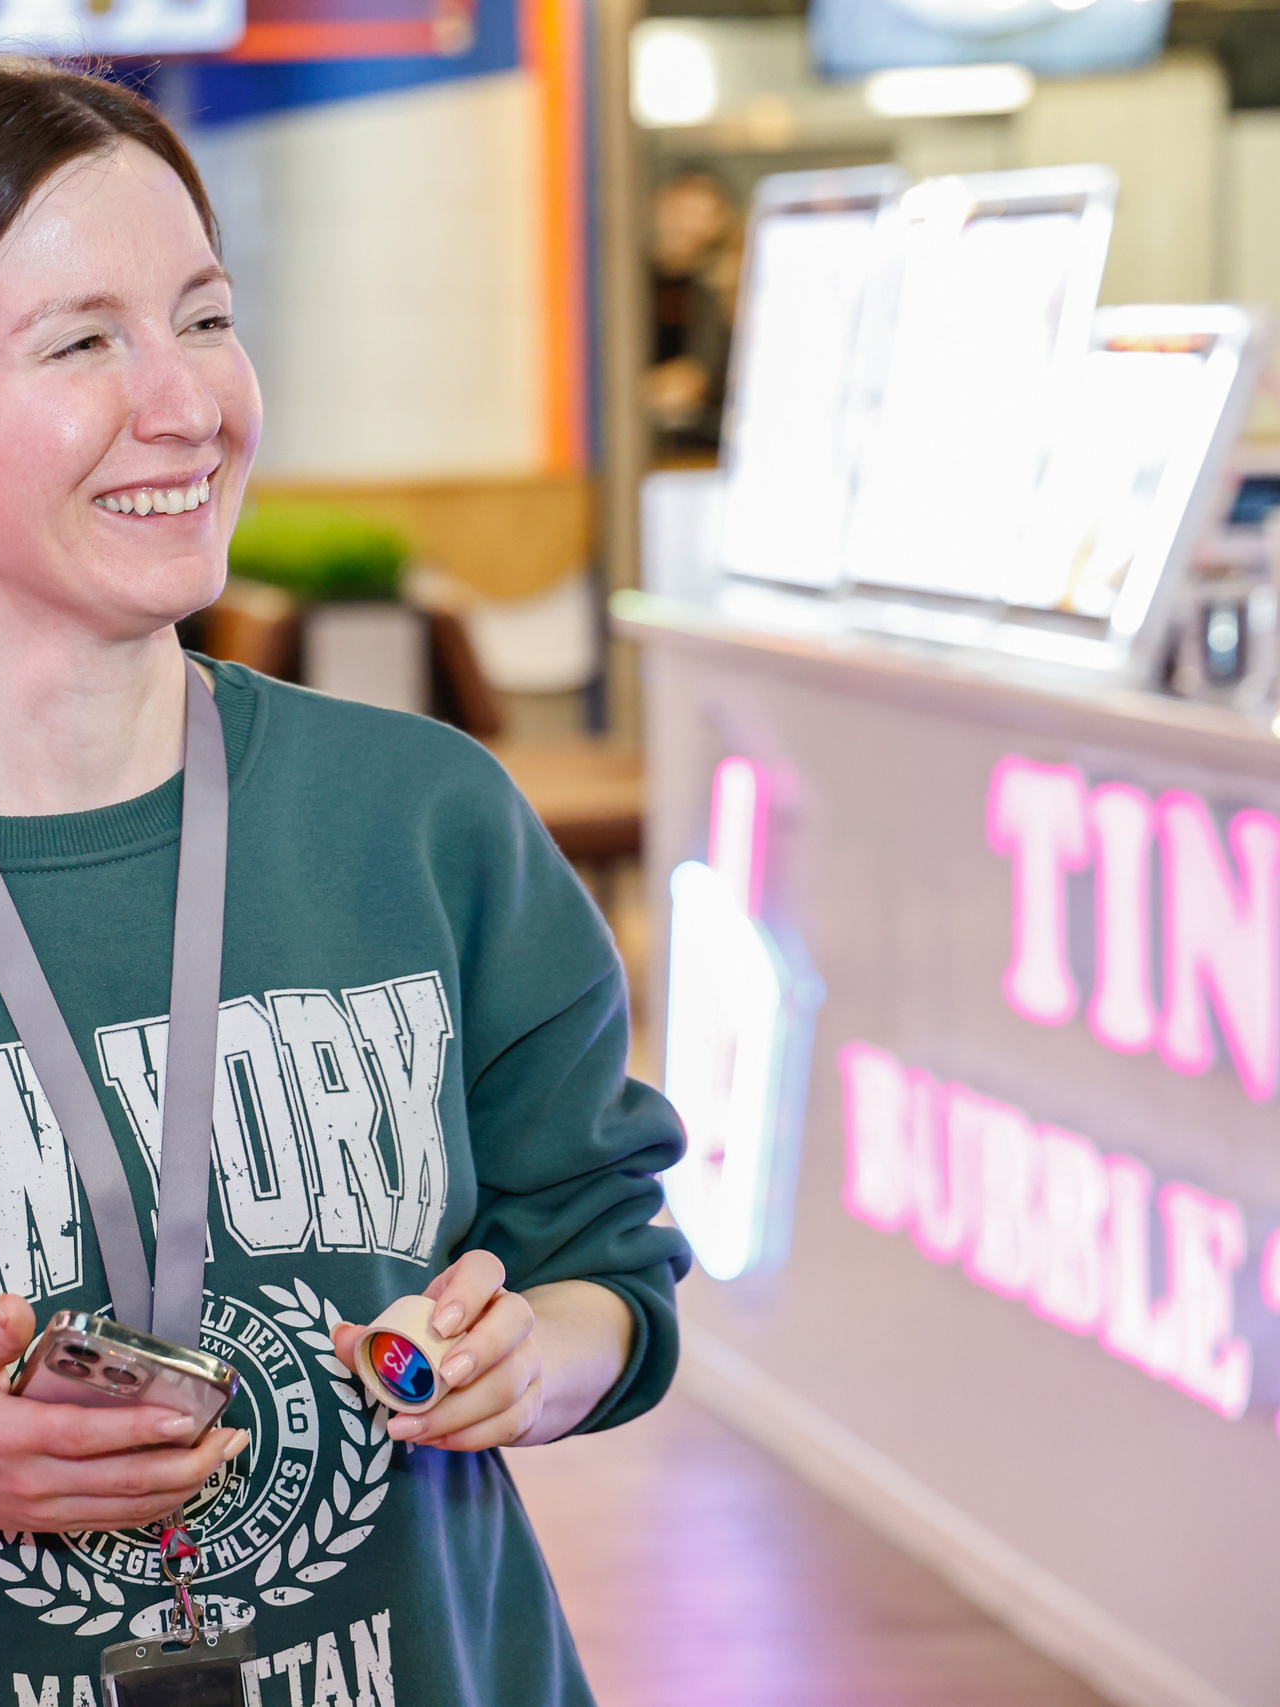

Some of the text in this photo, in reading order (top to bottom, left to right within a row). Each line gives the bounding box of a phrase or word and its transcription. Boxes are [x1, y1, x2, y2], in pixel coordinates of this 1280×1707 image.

[838, 1040, 1253, 1420] BUBBLE
[237, 1316, 294, 1380] DEPT.
[285, 1396, 309, 1434] 6
[67, 1530, 162, 1579] LLEGE
